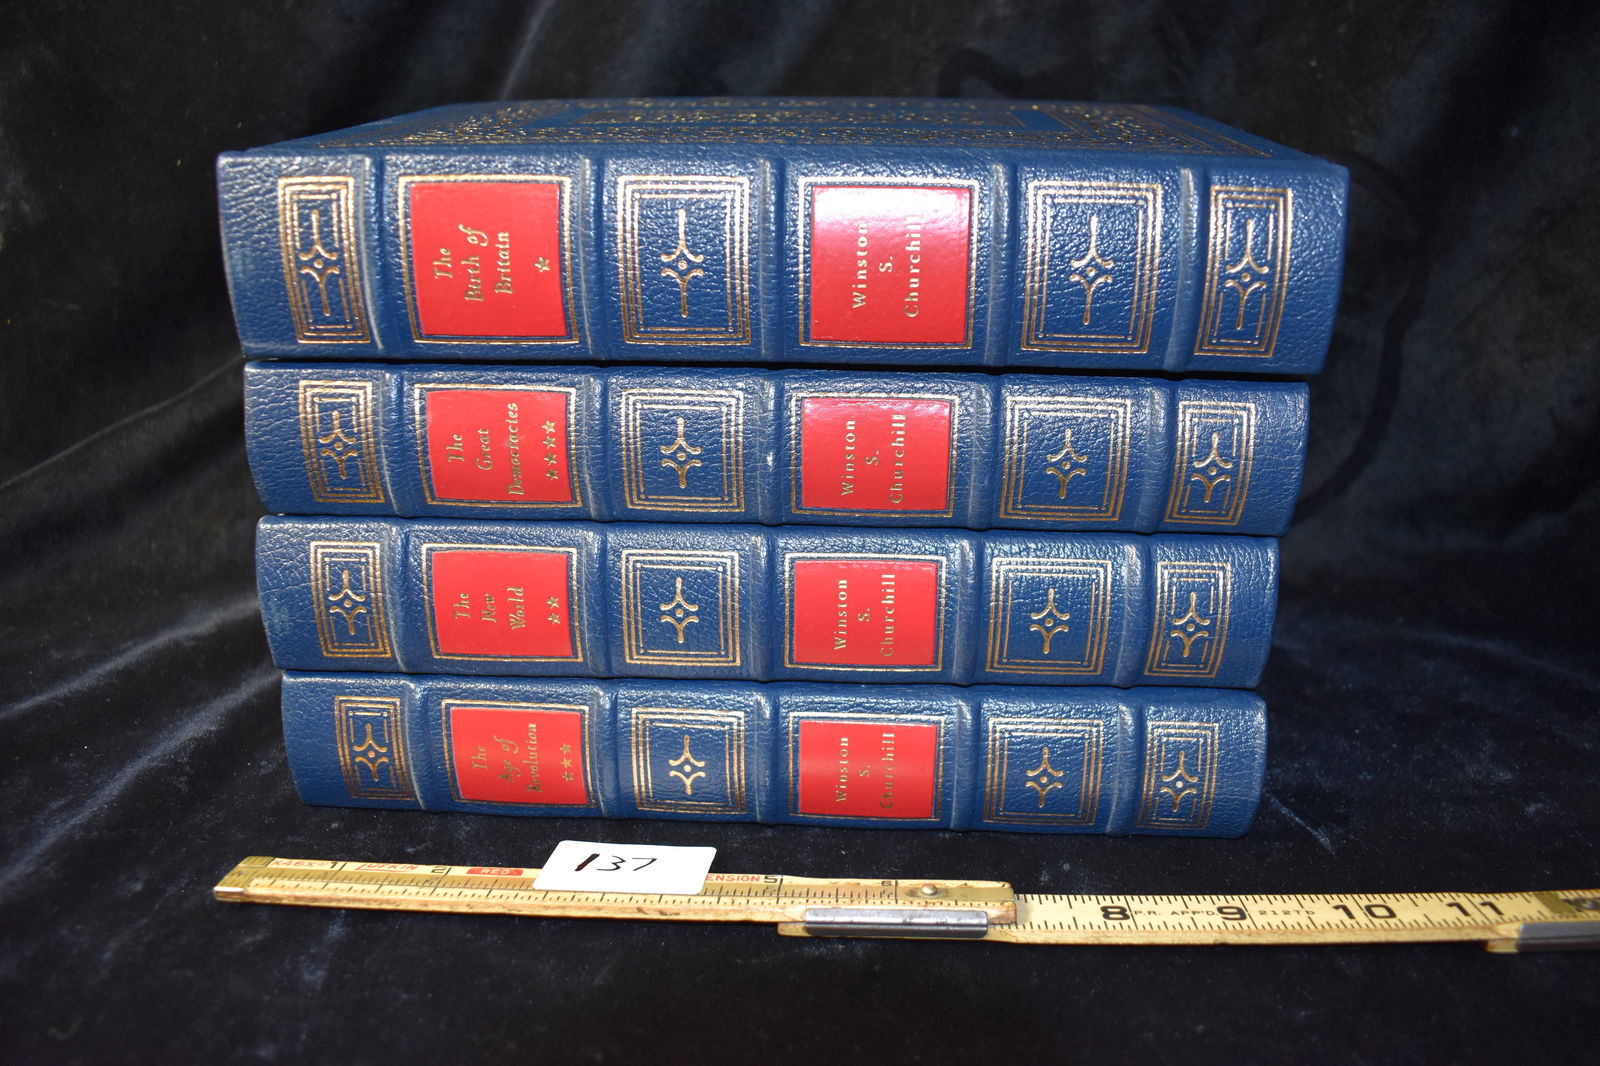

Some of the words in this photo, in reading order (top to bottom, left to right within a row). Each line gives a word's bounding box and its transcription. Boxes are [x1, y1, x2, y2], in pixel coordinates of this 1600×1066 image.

[458, 224, 488, 247] of
[432, 248, 453, 279] The
[494, 231, 513, 294] Britain
[852, 223, 868, 309] Winston
[879, 256, 894, 273] S.
[904, 214, 922, 318] Churchill
[461, 256, 484, 301] Birth
[446, 433, 465, 462] The
[475, 428, 494, 470] Great
[507, 402, 525, 496] Democracies
[841, 420, 856, 496] Winston
[865, 450, 880, 466] S.
[888, 414, 906, 504] Churchill
[453, 593, 472, 620] The
[481, 593, 497, 623] New
[506, 586, 526, 630] World
[833, 579, 848, 650] Winston
[857, 608, 871, 622] S.
[880, 574, 896, 657] Churchill
[470, 746, 489, 769] The
[492, 735, 520, 755] of
[522, 723, 543, 793] Revolution
[497, 759, 522, 783] Age
[835, 737, 849, 802] Winston
[858, 764, 872, 778] S.
[879, 733, 896, 809] Churchill
[431, 866, 446, 874] 2
[575, 853, 658, 871] 137
[705, 874, 760, 882] ENSION
[1100, 906, 1130, 920] 8
[1217, 906, 1247, 920] 9
[1333, 904, 1397, 920] 10
[1446, 902, 1503, 917] 11
